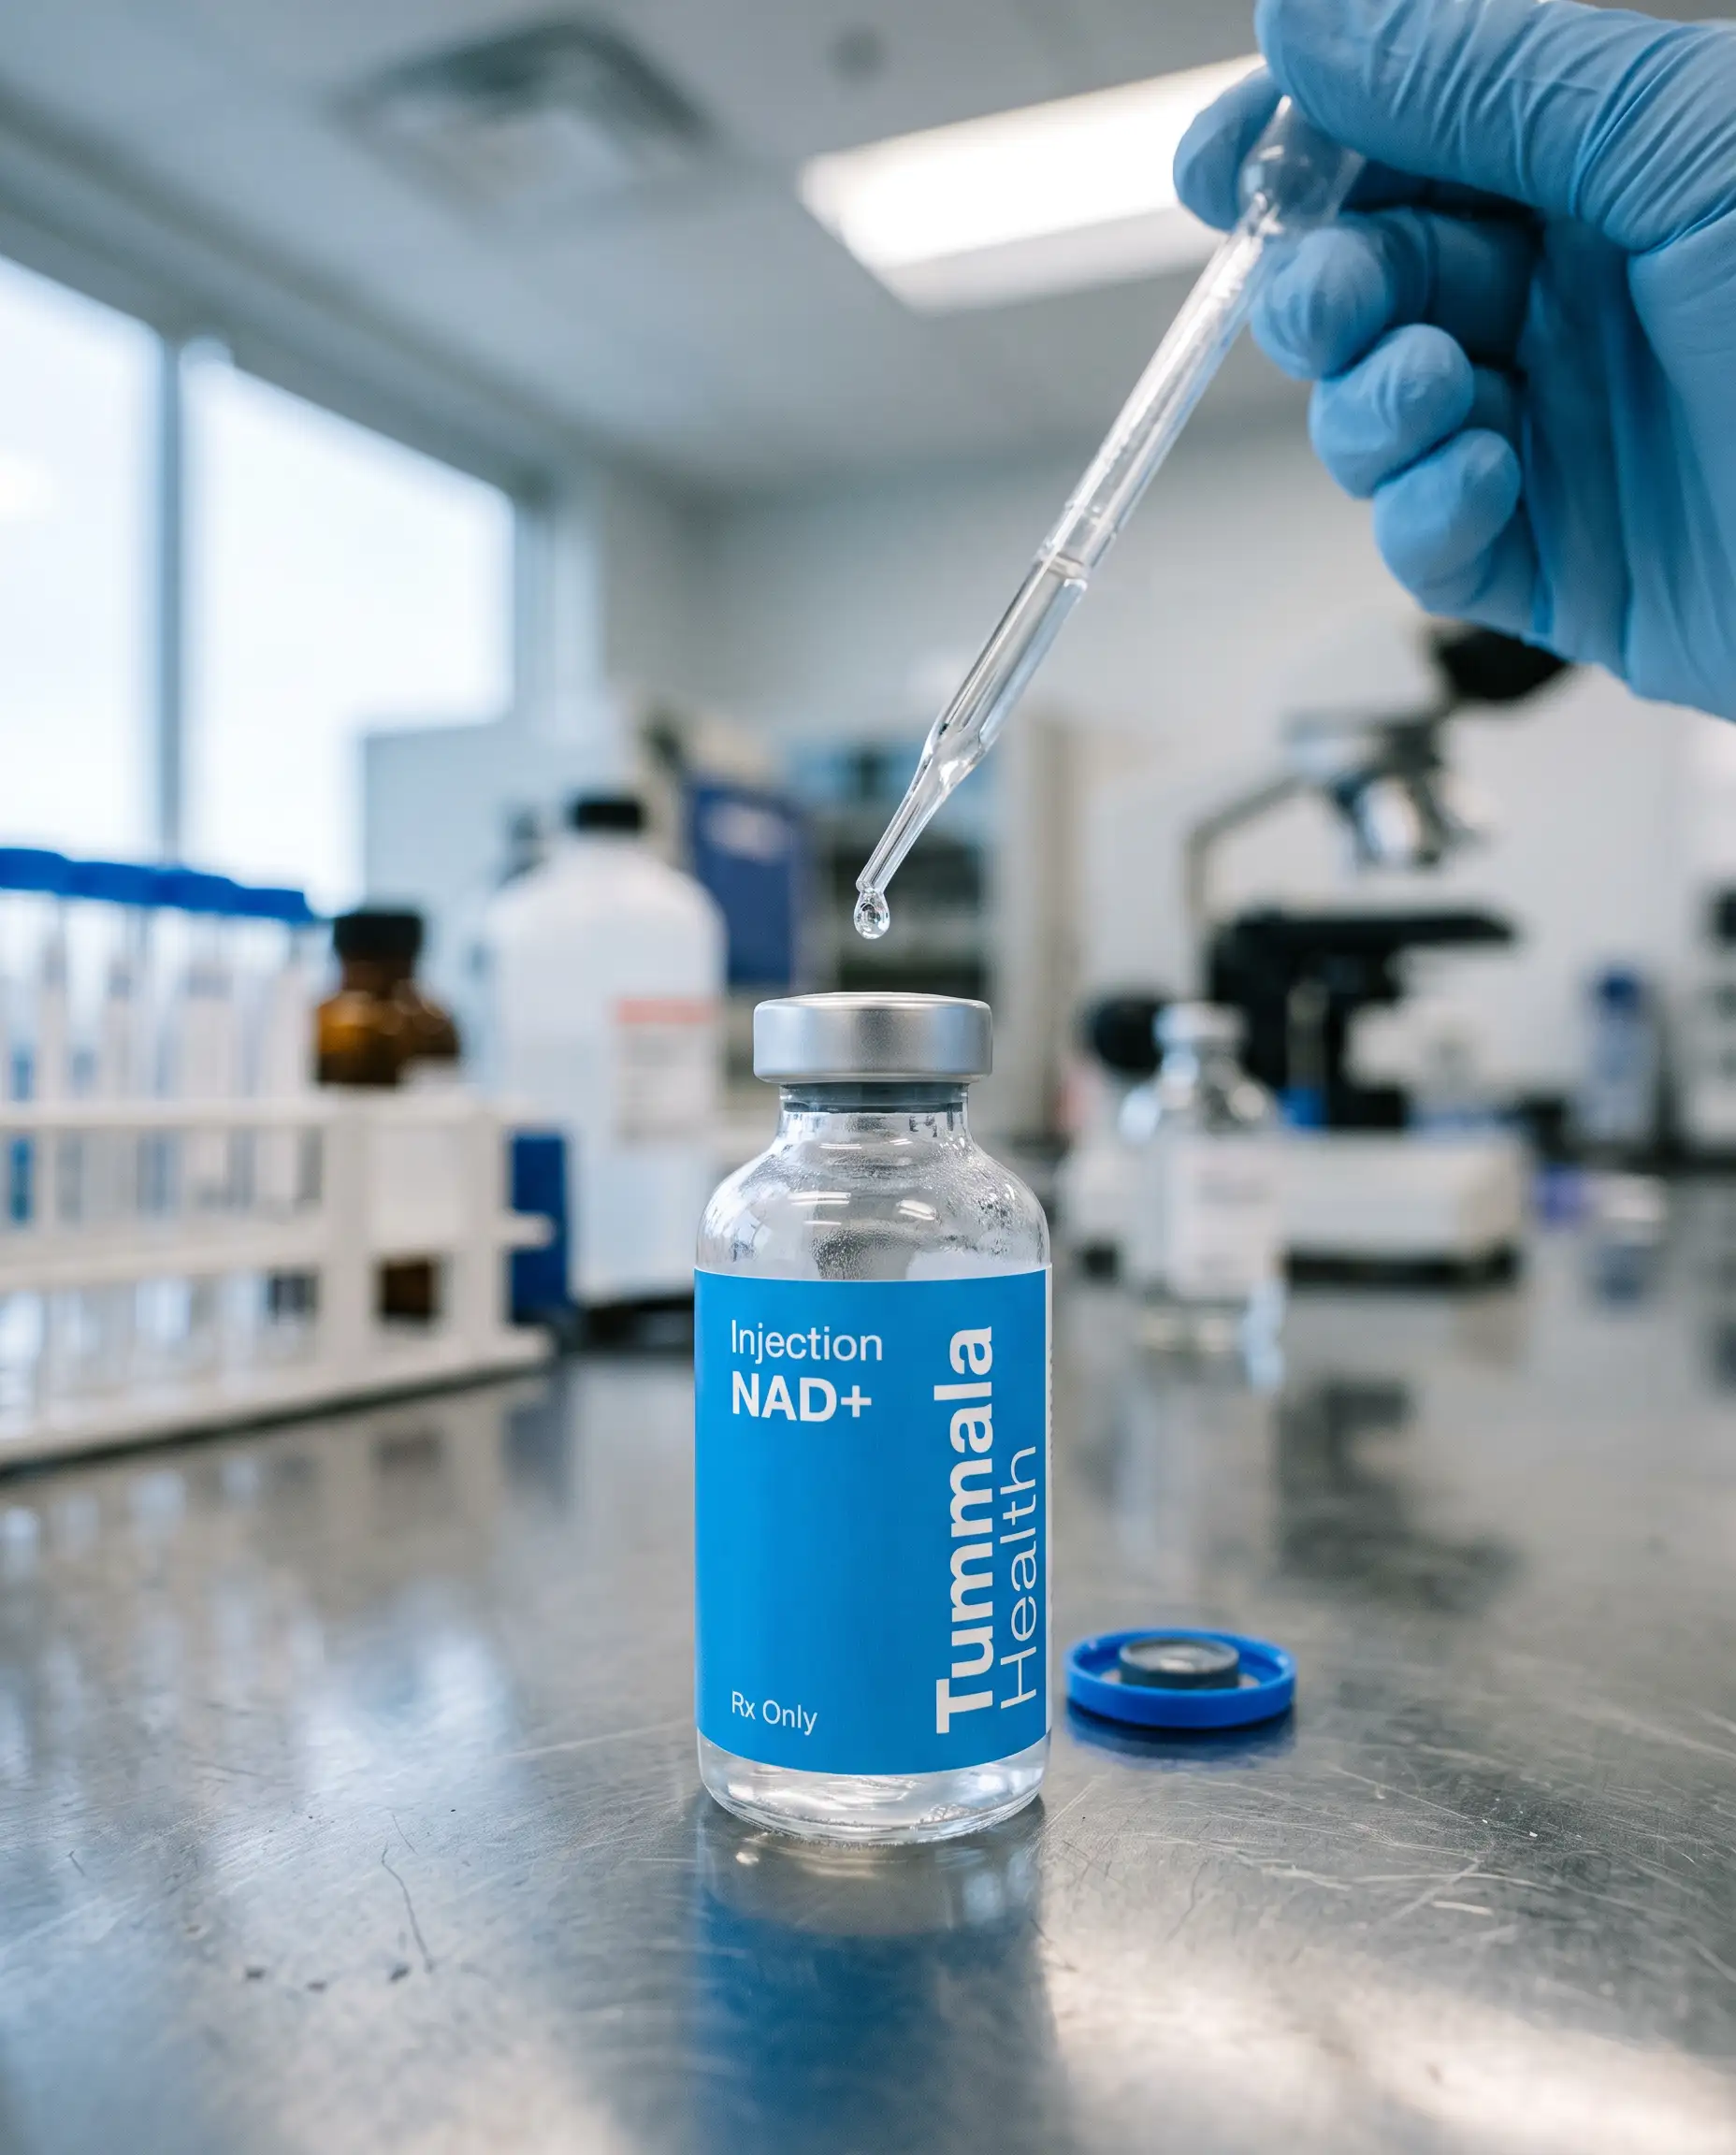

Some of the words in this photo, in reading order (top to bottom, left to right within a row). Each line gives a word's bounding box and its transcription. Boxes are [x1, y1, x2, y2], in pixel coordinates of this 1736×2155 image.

[732, 1320, 882, 1364] Injection
[732, 1371, 871, 1422] NAD+
[934, 1326, 993, 1733] Tummala
[1000, 1446, 1036, 1709] Health
[731, 1691, 755, 1719] Rx
[763, 1700, 817, 1735] Only
